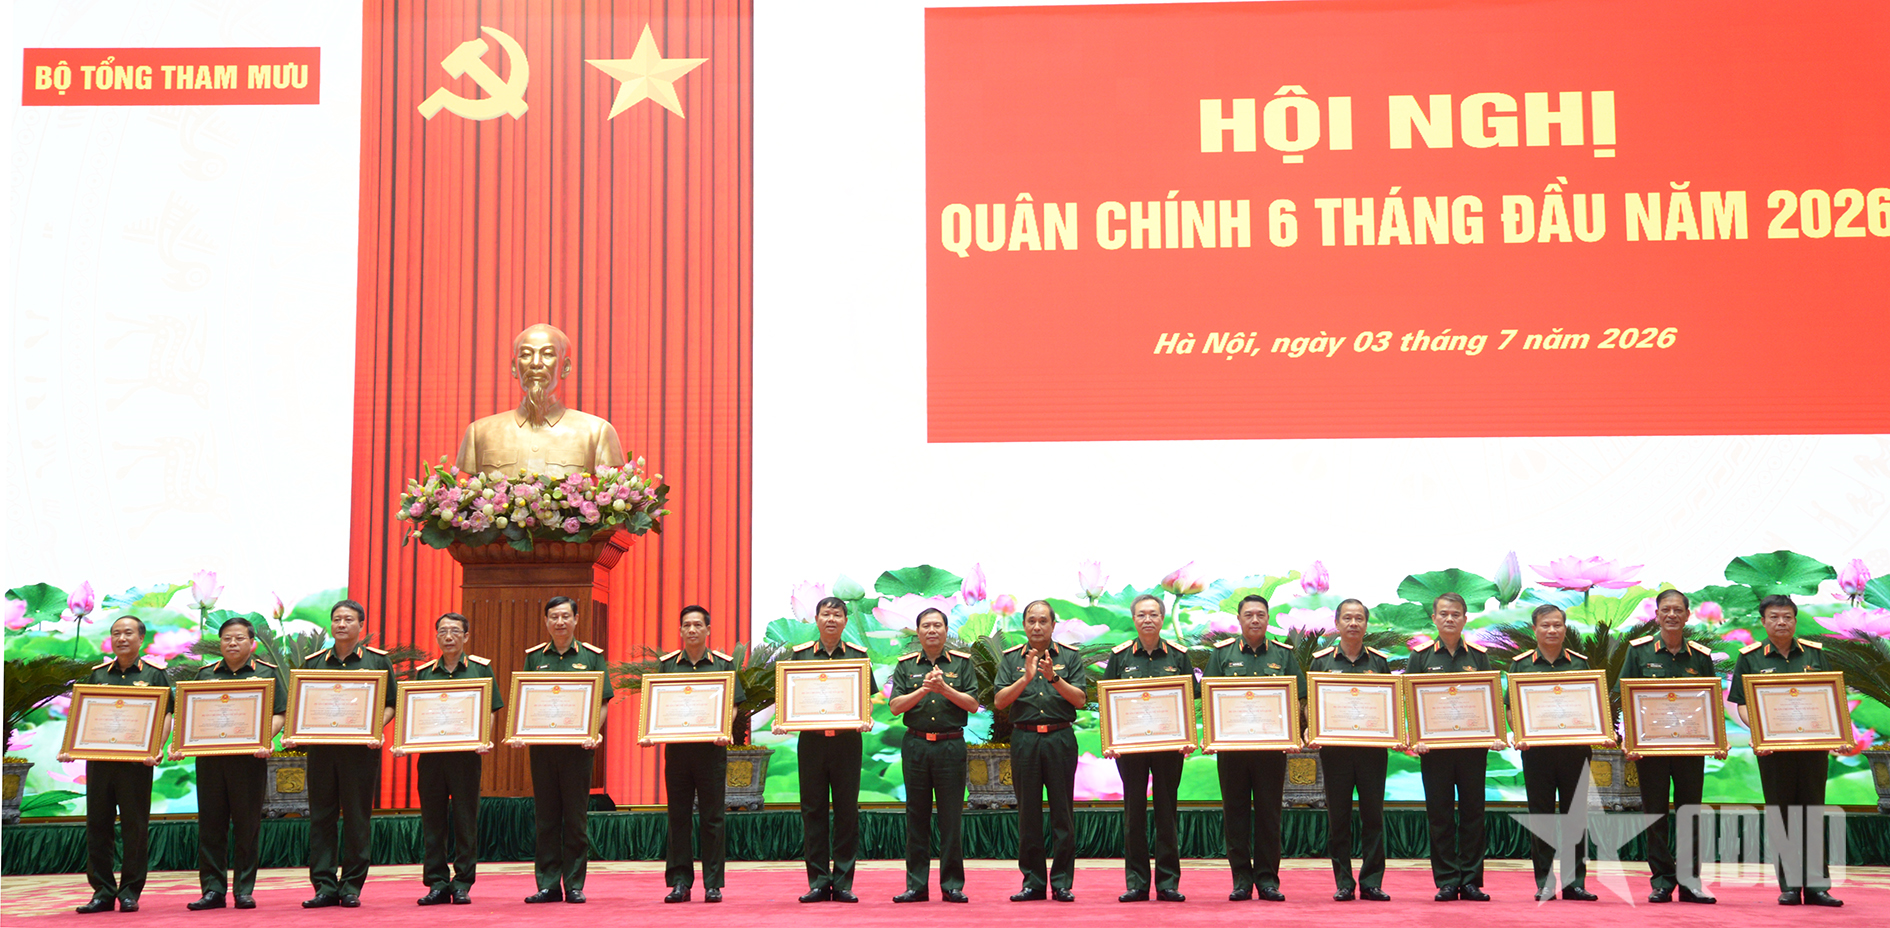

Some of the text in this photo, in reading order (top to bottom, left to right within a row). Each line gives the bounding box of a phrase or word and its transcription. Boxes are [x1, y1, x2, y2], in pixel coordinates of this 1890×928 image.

[35, 56, 309, 95] BỘ TỔNG THAM MƯU
[1199, 85, 1617, 164] HỘI NGHỊ
[940, 176, 1890, 258] QUÂN CHÍNH 6 THÁNG ĐẦU NĂM 2026
[1153, 327, 1679, 361] Hà Nội, ngày 03 tháng 7 năm 2026
